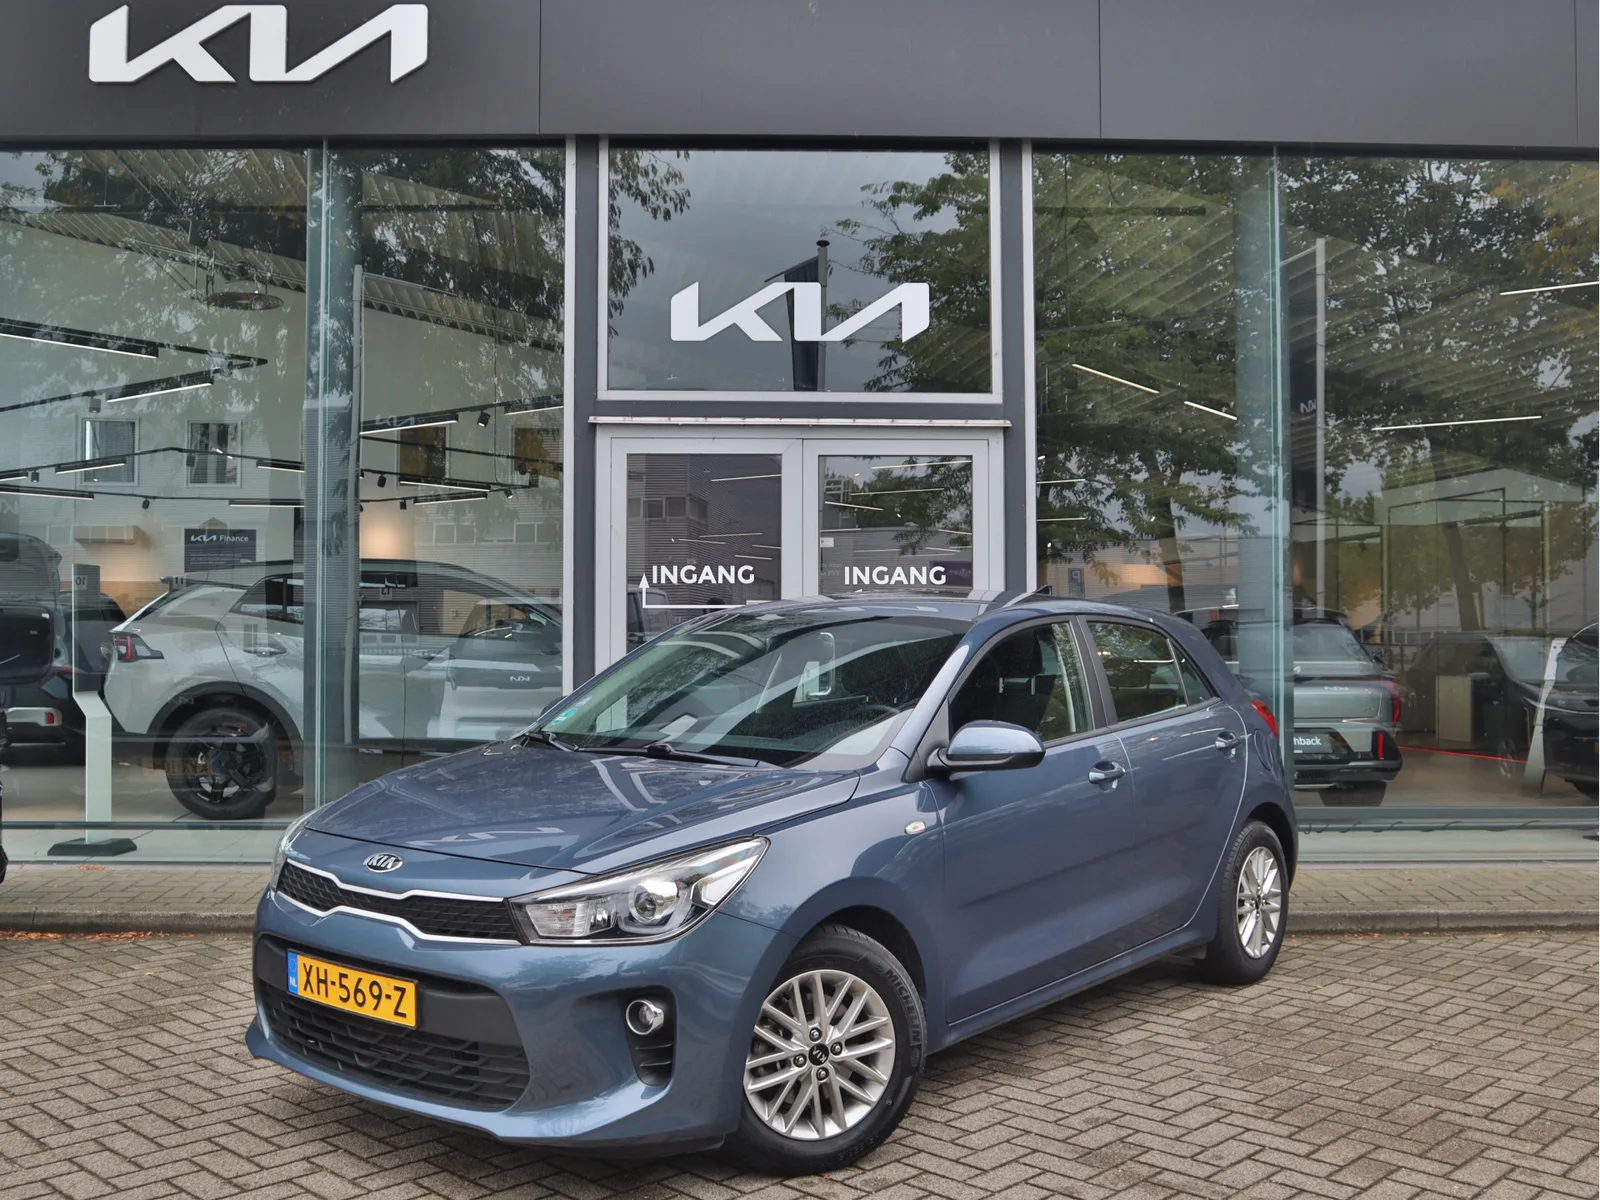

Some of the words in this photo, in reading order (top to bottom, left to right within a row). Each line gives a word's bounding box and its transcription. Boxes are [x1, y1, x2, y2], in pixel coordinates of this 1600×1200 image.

[89, 4, 428, 83] KIA
[671, 281, 930, 342] KIA
[219, 534, 249, 542] Finance
[652, 565, 755, 584] INGANG
[844, 566, 946, 585] INGANG
[1293, 737, 1322, 746] hback
[368, 854, 396, 869] KIA
[289, 976, 298, 988] NL
[303, 962, 407, 1018] XH-569-Z
[886, 968, 921, 1041] MICHELIN
[812, 1046, 827, 1064] KIA
